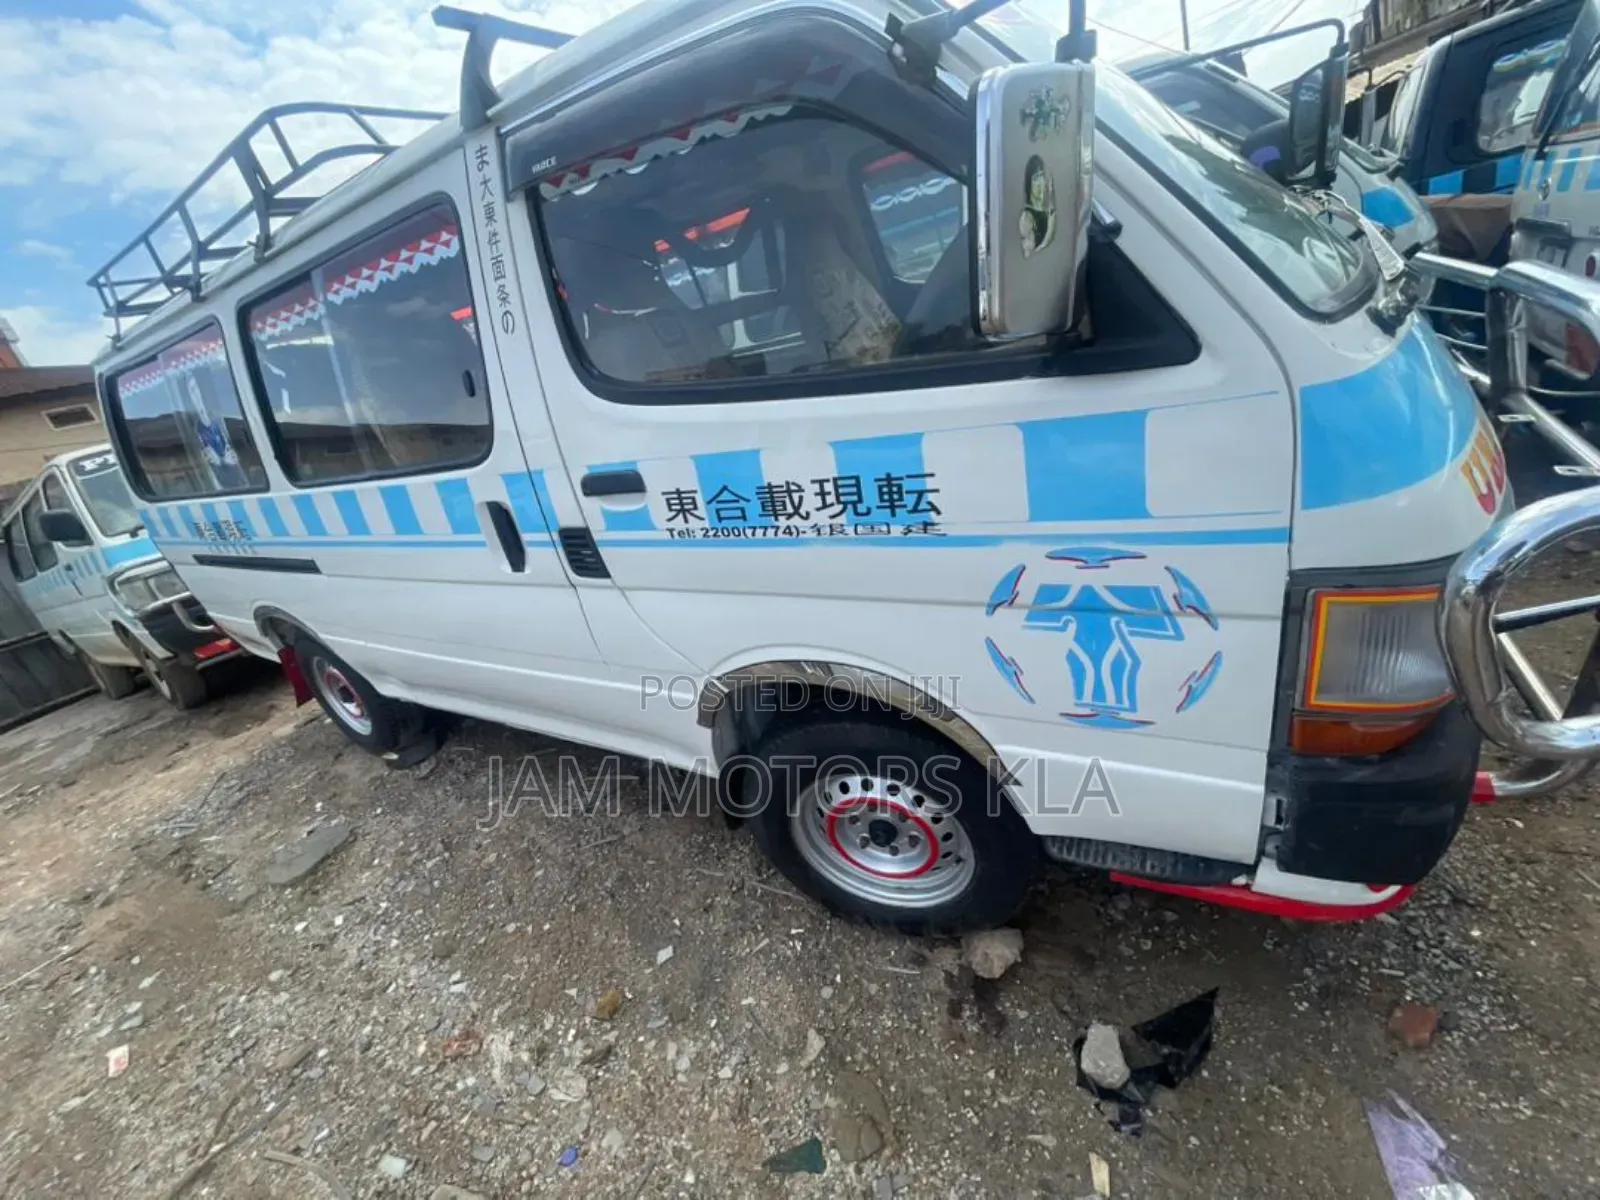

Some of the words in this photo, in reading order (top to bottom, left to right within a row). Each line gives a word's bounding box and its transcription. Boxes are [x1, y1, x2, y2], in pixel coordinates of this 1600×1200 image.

[661, 472, 943, 524] 東合載現転
[666, 527, 696, 540] Tel:
